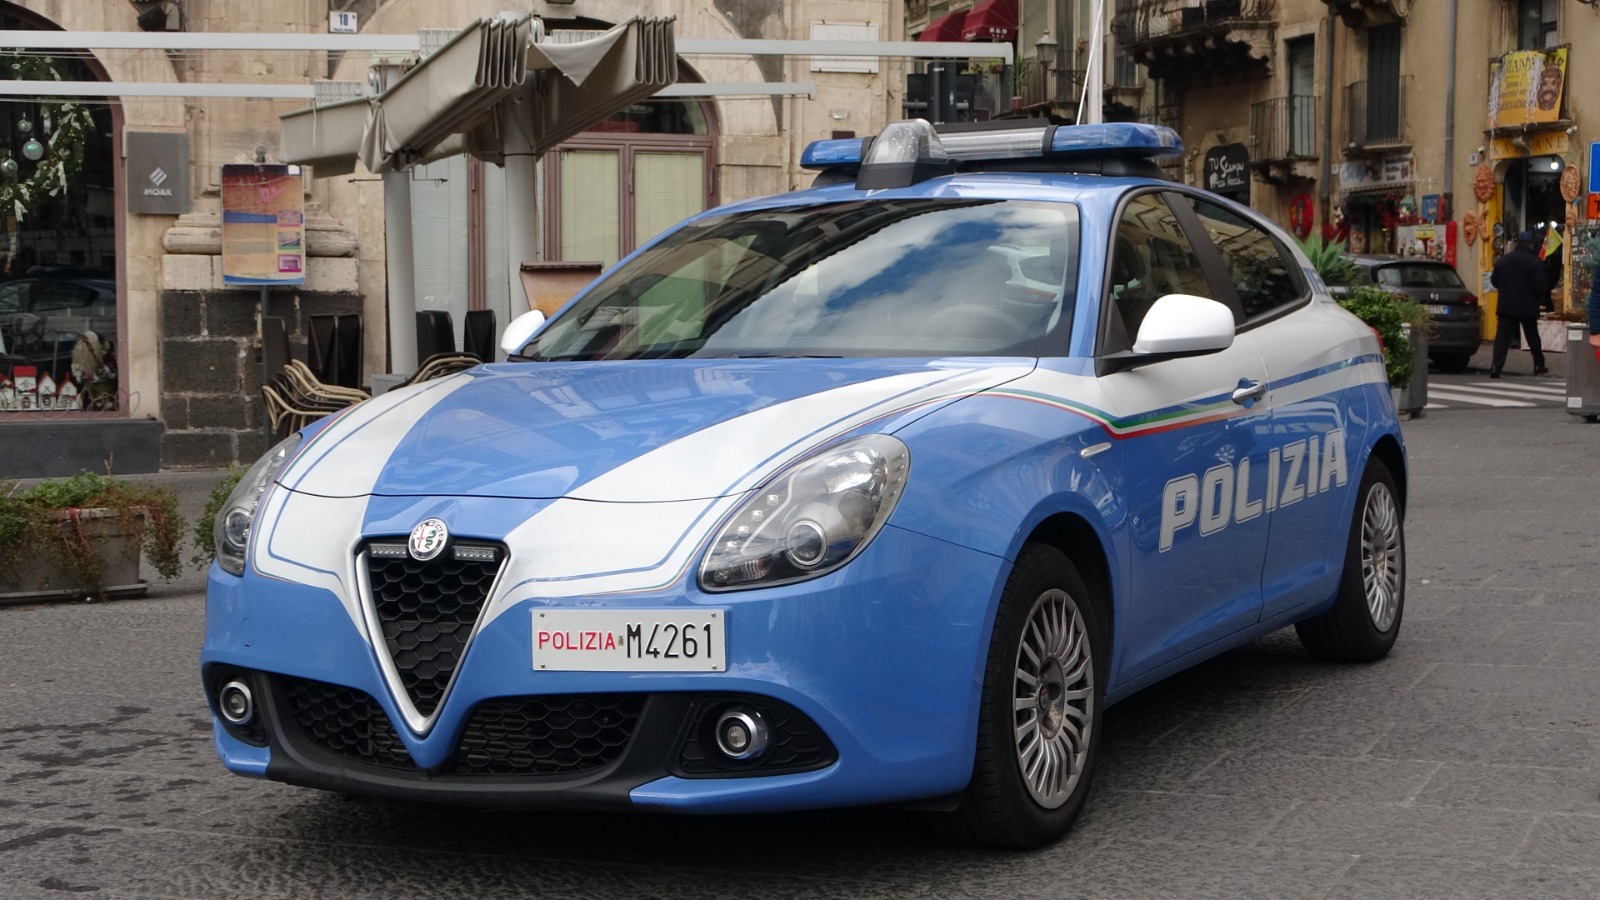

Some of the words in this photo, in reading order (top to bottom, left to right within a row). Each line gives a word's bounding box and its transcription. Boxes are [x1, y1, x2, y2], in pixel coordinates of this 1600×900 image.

[339, 13, 349, 26] 18
[144, 188, 173, 197] MOAK
[1160, 429, 1348, 552] POLIZIA
[538, 631, 616, 650] POLIZIA
[626, 623, 712, 659] M4261
